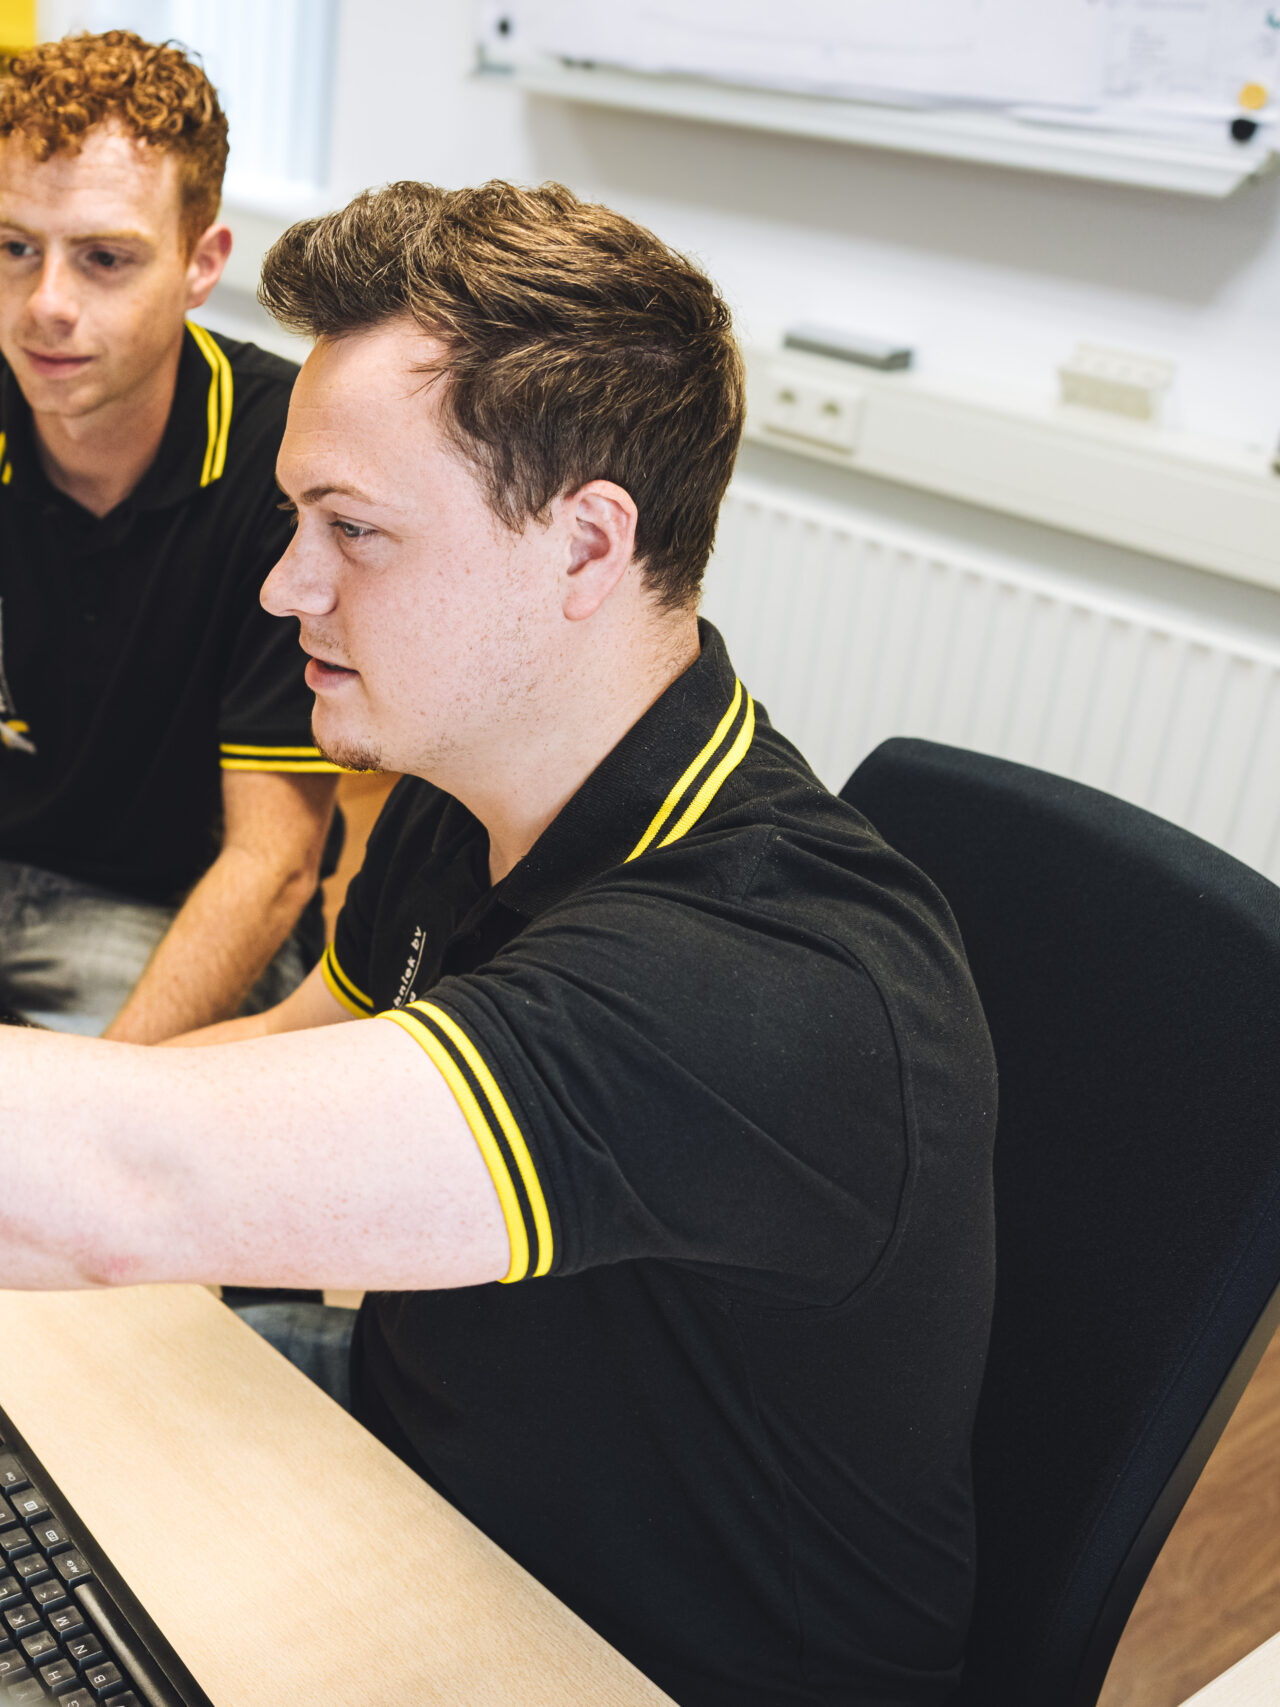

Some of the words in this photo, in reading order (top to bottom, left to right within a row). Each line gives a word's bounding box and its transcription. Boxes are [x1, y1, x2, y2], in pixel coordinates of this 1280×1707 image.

[13, 1614, 26, 1625] K
[56, 1615, 70, 1627] M
[29, 1644, 43, 1653] J
[74, 1644, 88, 1655] N
[47, 1670, 62, 1681] H
[93, 1674, 107, 1684] B
